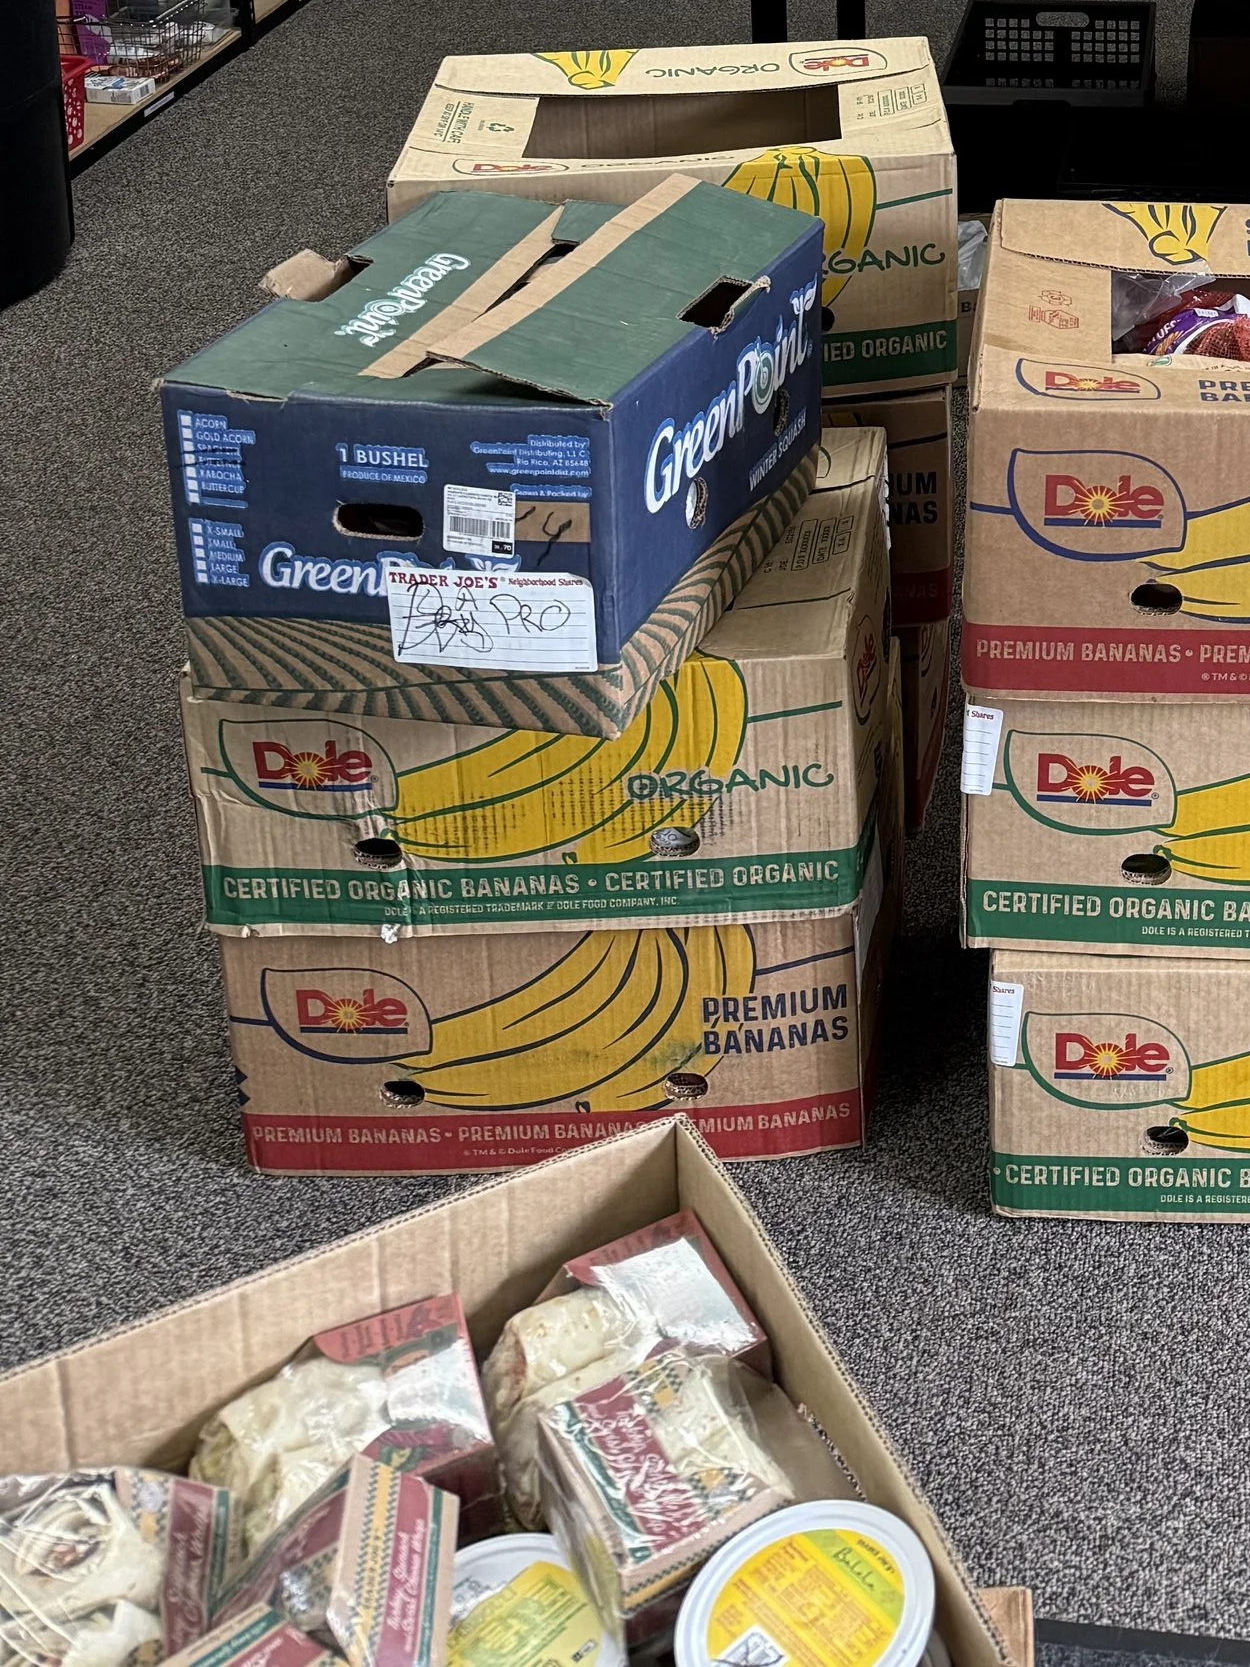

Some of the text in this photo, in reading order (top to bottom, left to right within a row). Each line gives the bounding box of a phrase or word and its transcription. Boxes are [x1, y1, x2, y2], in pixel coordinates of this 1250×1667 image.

[646, 63, 780, 78] ORGANIC
[335, 253, 471, 346] GreenPoint
[861, 330, 947, 358] ORGANIC
[1045, 371, 1141, 391] Dole
[644, 273, 817, 513] GreenPoint
[195, 418, 226, 429] ACORN
[221, 433, 254, 444] ACORN
[530, 439, 572, 449] Distributed
[357, 449, 428, 467] BUSHEL
[749, 413, 806, 491] WINTER SQUASH
[200, 470, 242, 481] KABOCHA
[343, 470, 426, 484] PRODUCE MEXICO
[489, 467, 589, 477] www.greenpointdist.com
[201, 482, 245, 493] BUTTERCUP
[1044, 474, 1164, 521] Dole
[207, 527, 244, 538] X-SMALL
[208, 539, 236, 549] SMALL
[209, 551, 245, 562] MEDIUM
[210, 563, 238, 573] LARGE
[212, 576, 249, 586] X-LARGE
[389, 572, 583, 589] TRADER JOE'S Neighborhood Shares
[977, 638, 1074, 660] PREMIUM
[1081, 642, 1181, 662] BANANAS
[252, 740, 373, 784] Dole
[627, 762, 834, 801] ORGANIC
[1036, 753, 1155, 797] Dole
[223, 860, 839, 902] CERTIFIED ORGANIC BANANAS CERTIFIED ORGANIC
[982, 890, 1101, 917] CERTIFIED
[1108, 896, 1215, 922] ORGANIC
[1142, 926, 1165, 935] DOLE
[1188, 927, 1243, 939] REGISTERED
[296, 989, 407, 1029] Dole
[702, 984, 849, 1025] PREMIUM
[702, 1015, 850, 1056] BANANAS
[1055, 1033, 1170, 1075] Dole
[253, 1102, 850, 1144] PREMIUM BANANAS PREMIUM BANANAS
[1005, 1164, 1120, 1187] CERTIFIED
[1128, 1166, 1232, 1189] ORGANIC
